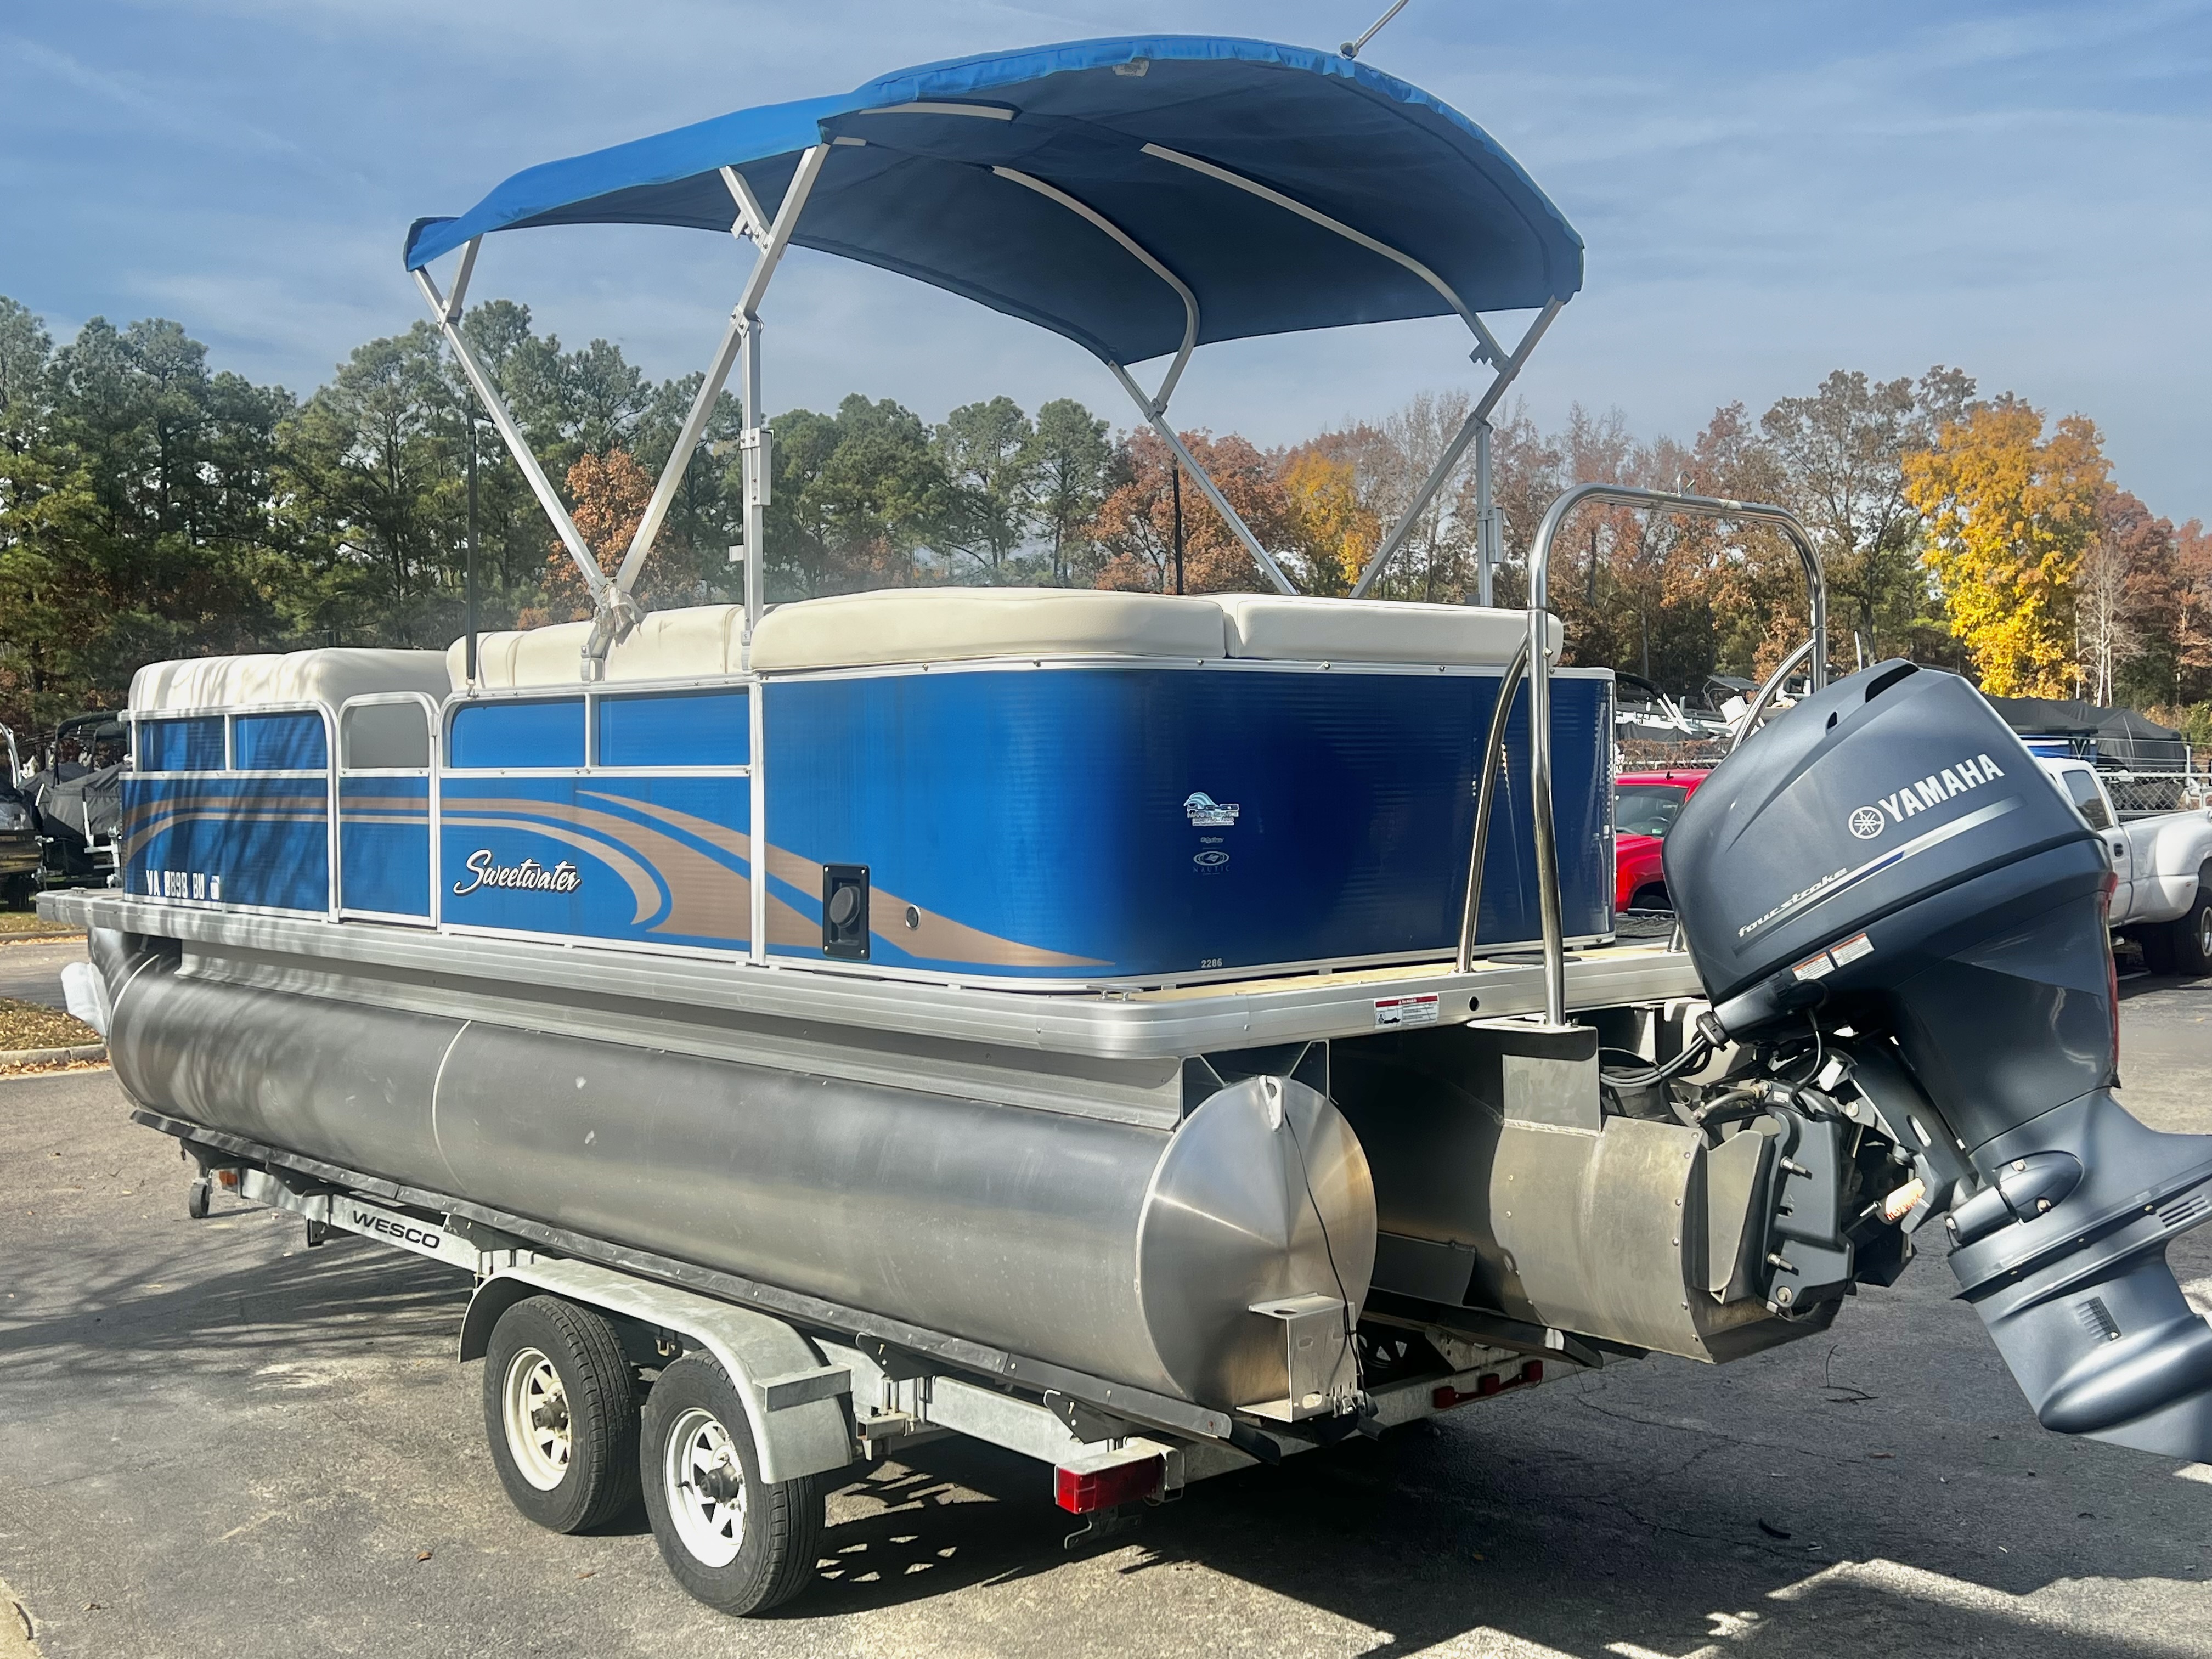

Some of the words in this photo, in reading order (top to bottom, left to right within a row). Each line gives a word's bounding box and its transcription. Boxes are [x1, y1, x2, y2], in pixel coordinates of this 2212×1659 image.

[1877, 753, 2005, 823] YAMAHA
[146, 870, 161, 896] VA
[453, 849, 582, 896] Sweetwater
[1201, 958, 1222, 968] 2286
[353, 1211, 440, 1249] WESCO
